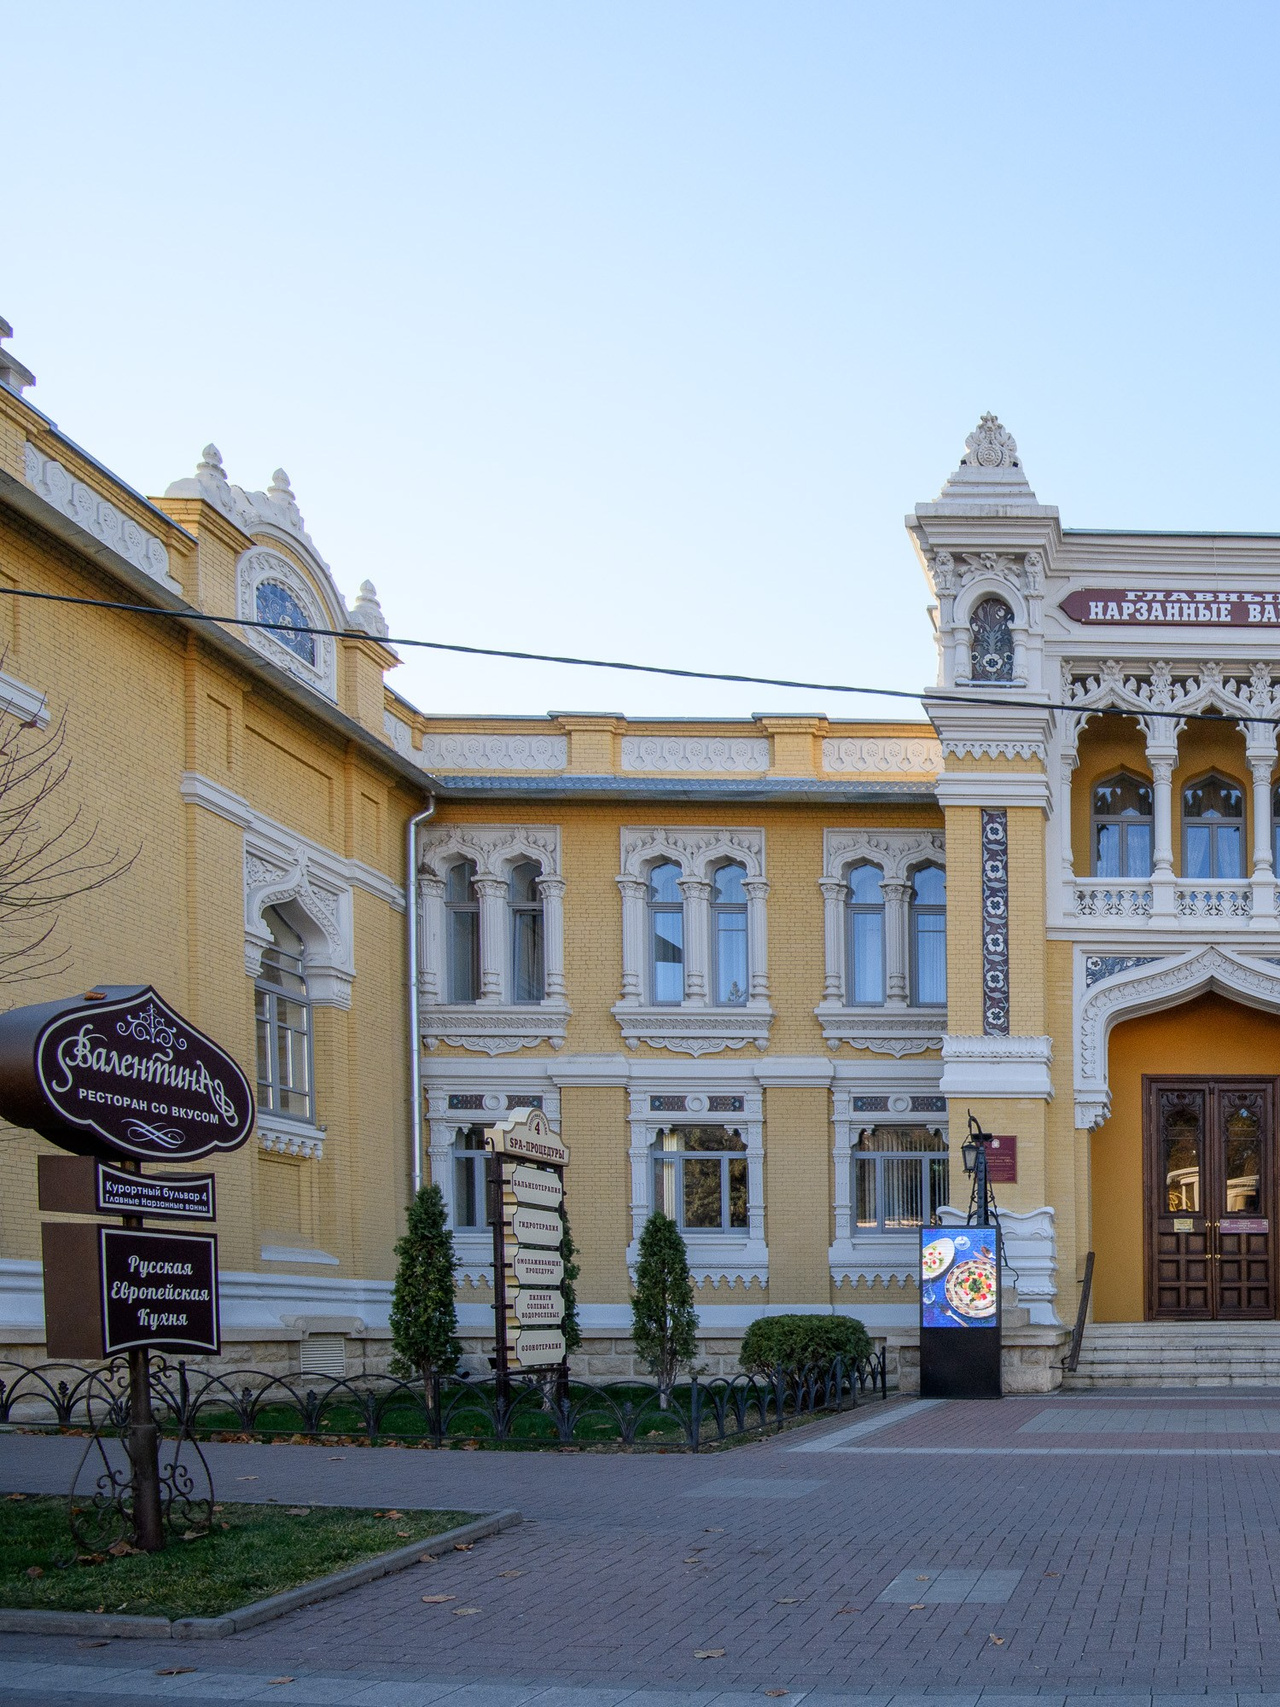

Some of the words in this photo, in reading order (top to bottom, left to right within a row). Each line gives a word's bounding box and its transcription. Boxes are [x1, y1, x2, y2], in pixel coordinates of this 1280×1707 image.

[1089, 601, 1232, 622] НАРЗАННЫЕ
[79, 1088, 148, 1112] РЕСТОРАН
[151, 1102, 168, 1115] СО
[171, 1106, 219, 1124] ВКУСОМ
[534, 1121, 541, 1135] 4
[510, 1137, 565, 1160] SPA-ПРОЦЕДУРЫ
[106, 1181, 161, 1197] Курортный
[162, 1187, 200, 1202] бульвар
[201, 1192, 208, 1201] 4
[105, 1194, 140, 1206] Главные
[141, 1197, 184, 1210] Нарзанные
[185, 1203, 208, 1212] ванны
[128, 1254, 193, 1278] Русская
[111, 1281, 210, 1304] Европейская
[137, 1308, 189, 1331] Кухня
[521, 1342, 562, 1353] ОЗОНОТЕРАПИЯ
